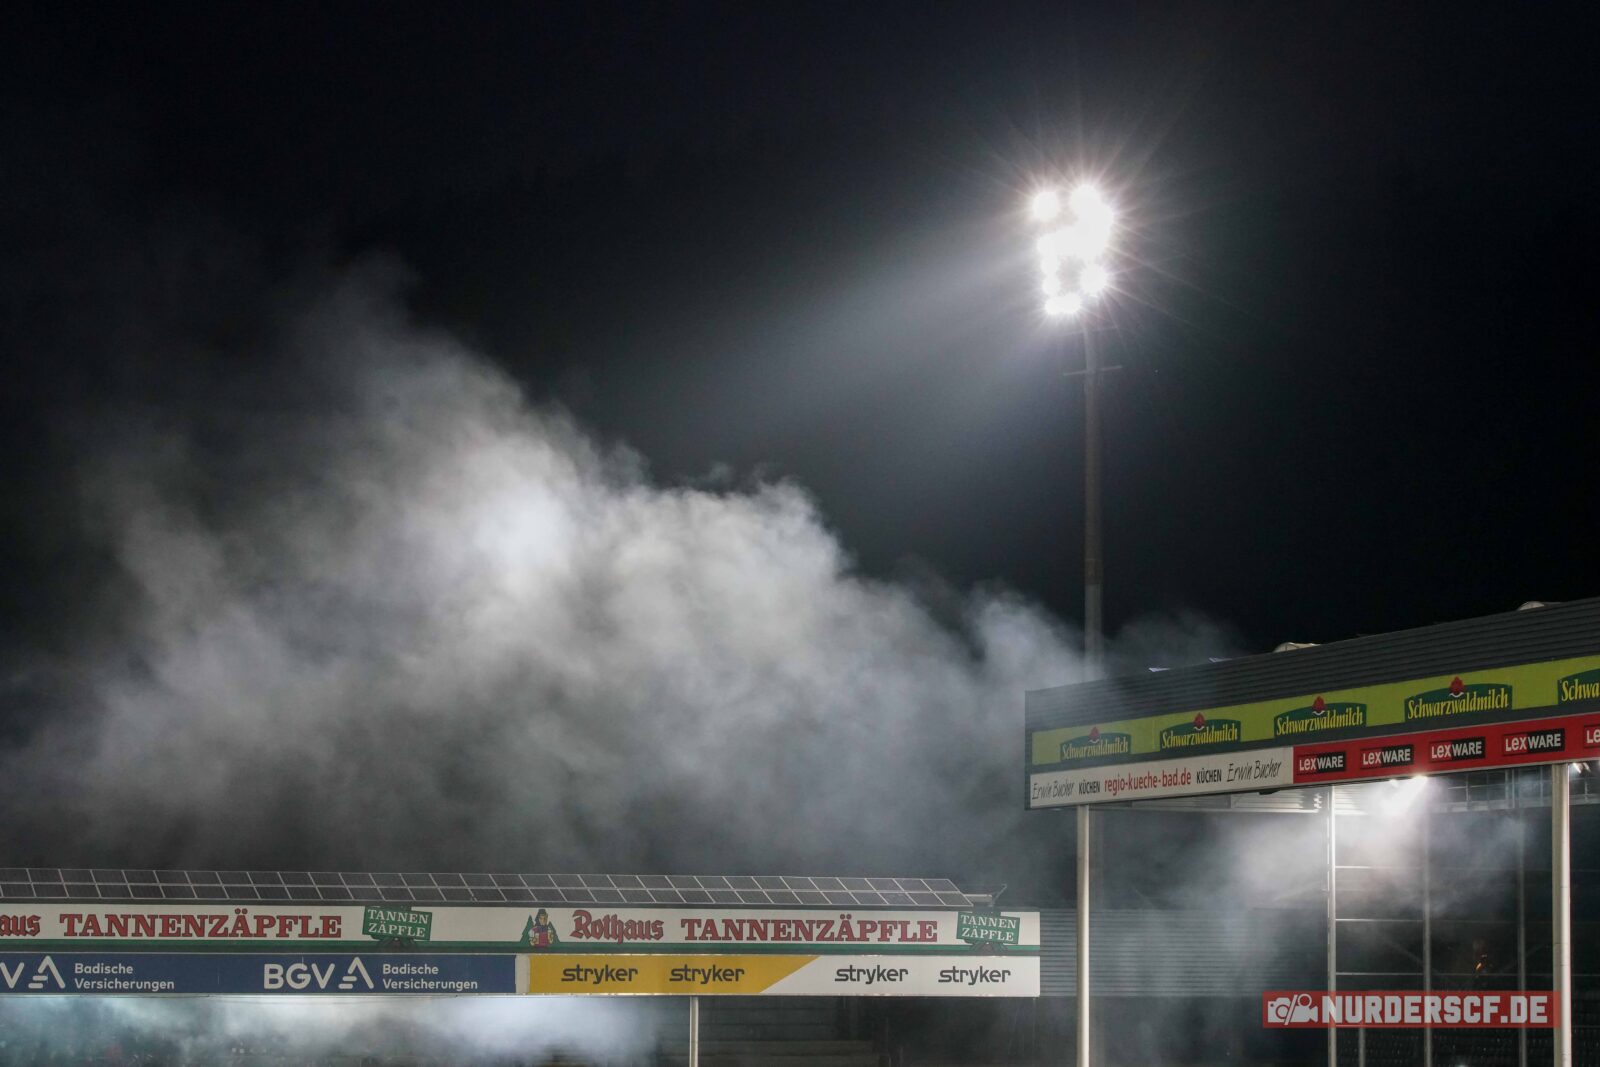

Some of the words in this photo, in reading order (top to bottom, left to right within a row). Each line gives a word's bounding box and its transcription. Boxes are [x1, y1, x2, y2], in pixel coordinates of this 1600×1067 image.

[1408, 689, 1509, 720] Schwarzwaldmilch
[1276, 707, 1363, 736] Schwarzwaldmilch
[1162, 723, 1238, 749] Schwarzwaldmilch
[1062, 736, 1128, 760] Schwarzwaldmilch
[1032, 781, 1051, 800] Erwin
[1052, 779, 1075, 797] Bucher
[1079, 779, 1101, 794] KÜCHEN
[1104, 768, 1191, 795] regio-kueche-bad.de
[1196, 768, 1222, 782] KÜCHEN
[1227, 763, 1252, 782] Erwin
[1253, 759, 1281, 778] Bucher
[60, 908, 341, 938] TANNENZÄPFLE
[367, 908, 429, 923] TANNEN
[960, 914, 1017, 927] TANNEN
[368, 919, 425, 938] ZÄPFLE
[570, 910, 663, 943] Rothaus
[681, 914, 938, 942] TANNENZÄPFLE
[961, 925, 1014, 942] ZÄPFLE
[75, 963, 133, 974] Badische
[382, 963, 439, 975] Badische
[561, 964, 638, 984] stryker
[669, 964, 744, 984] stryker
[835, 964, 908, 983] stryker
[938, 966, 1011, 985] stryker
[74, 977, 175, 992] Versicherungen
[382, 978, 478, 992] Versicherungen
